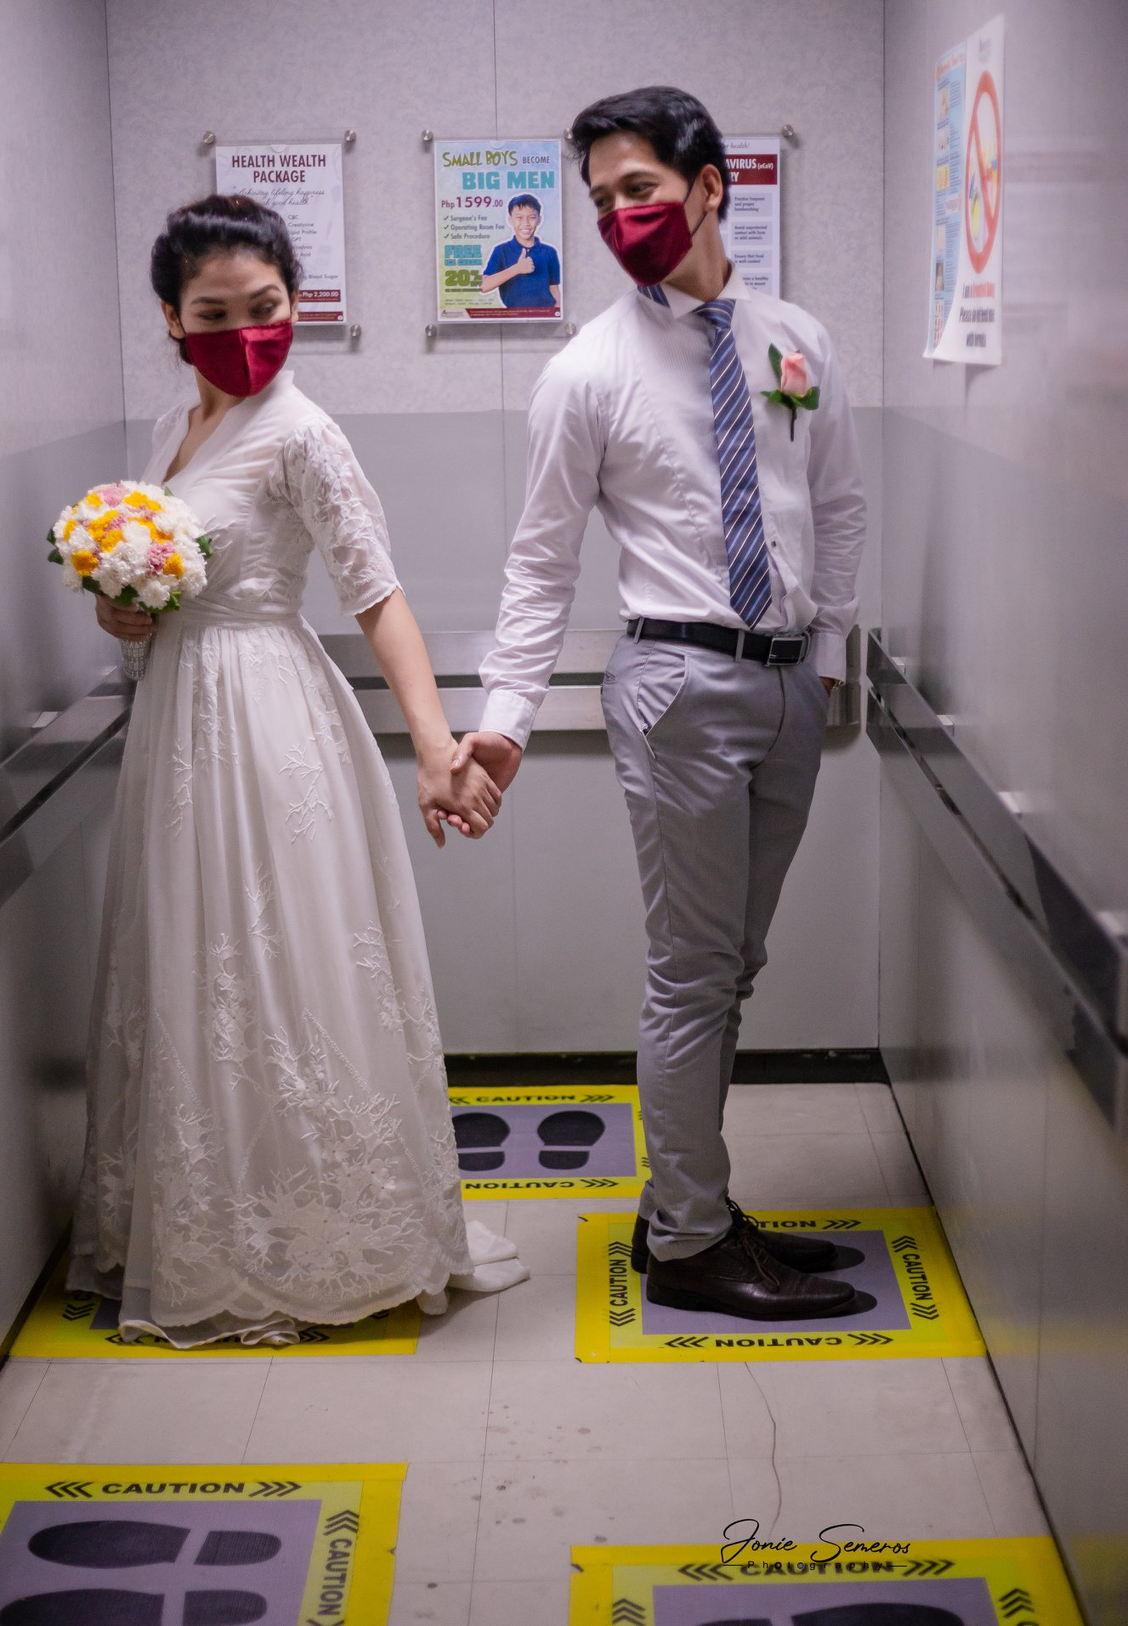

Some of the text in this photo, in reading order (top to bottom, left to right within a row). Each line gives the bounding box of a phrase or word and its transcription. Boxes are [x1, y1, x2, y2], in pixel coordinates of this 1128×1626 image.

[232, 154, 326, 168] HEALTH WEALTH
[442, 150, 482, 167] SMALL
[486, 150, 518, 166] BOYS
[254, 170, 306, 183] PACKAGE
[462, 170, 554, 190] BIG MEN
[442, 200, 454, 210] Php
[444, 245, 482, 258] FREE
[465, 1181, 575, 1189] CAUTION
[758, 1220, 816, 1228] TION
[609, 1259, 628, 1306] CAUTION
[902, 1254, 930, 1300] CAUTION
[715, 1337, 843, 1348] CAUTION
[102, 1482, 244, 1494] CAUTION
[739, 1560, 894, 1577] CAUTION
[317, 1538, 352, 1616] CAUTION
